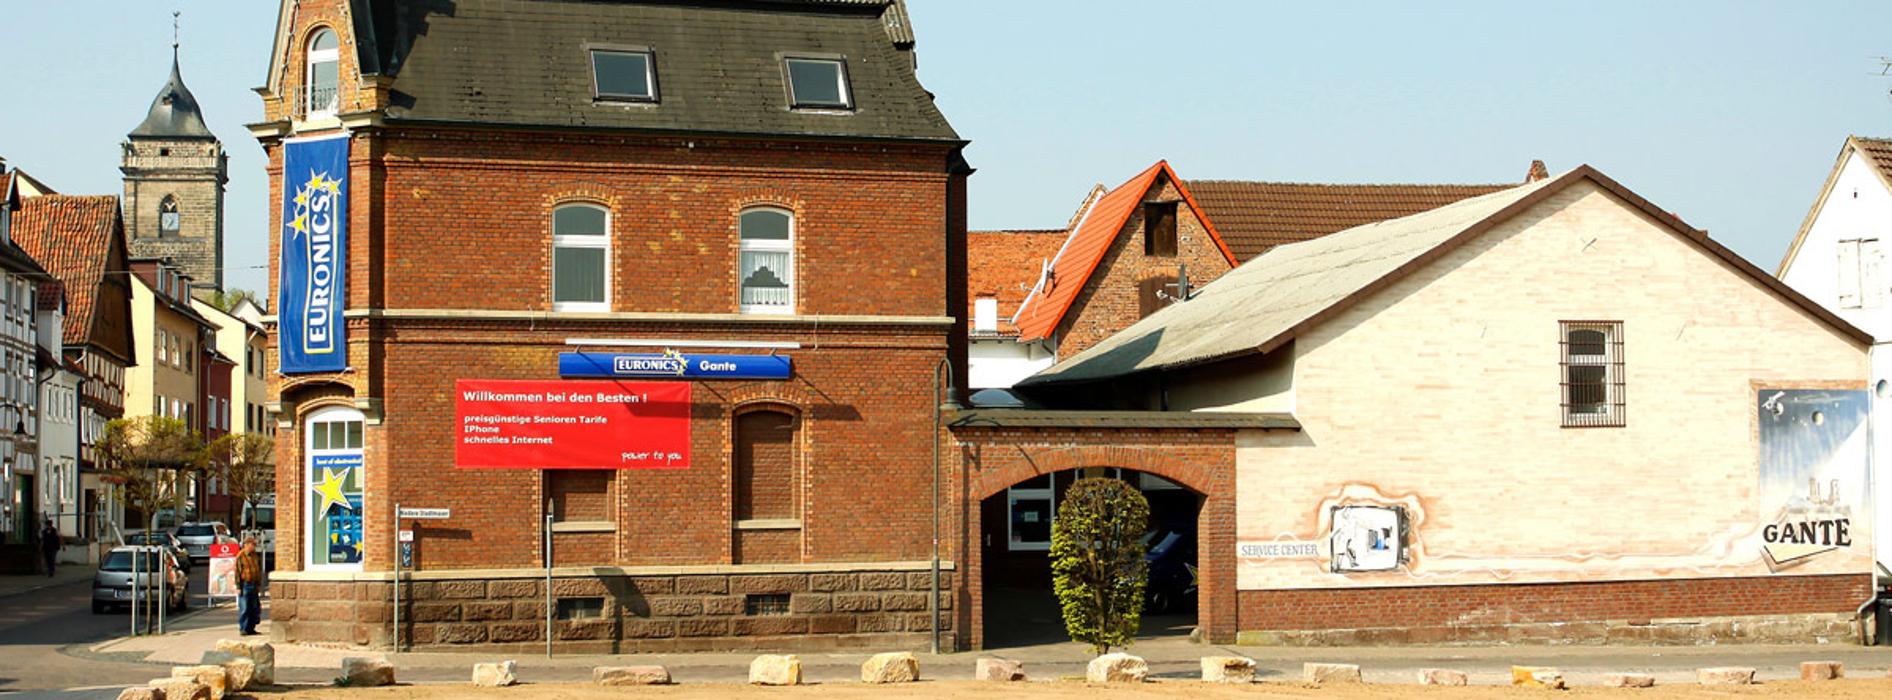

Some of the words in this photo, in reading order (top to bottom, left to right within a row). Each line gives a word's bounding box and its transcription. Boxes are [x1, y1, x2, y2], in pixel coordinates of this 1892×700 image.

[309, 194, 332, 343] EURONICS
[618, 360, 678, 370] EURONICS
[699, 360, 737, 371] Gante
[463, 391, 543, 401] Willkommen
[546, 392, 567, 402] bei
[569, 392, 593, 402] den
[597, 393, 640, 403] Besten
[464, 414, 531, 424] preisgünstige
[533, 415, 577, 424] Senioren
[579, 415, 608, 424] Tarife
[464, 425, 500, 433] IPhone
[464, 436, 510, 444] schnelles
[512, 436, 553, 444] Internet
[622, 451, 650, 462] power
[653, 451, 664, 460] to
[1763, 518, 1851, 546] GANTE
[1241, 545, 1279, 557] SERVICE
[1281, 544, 1319, 556] CENTER
